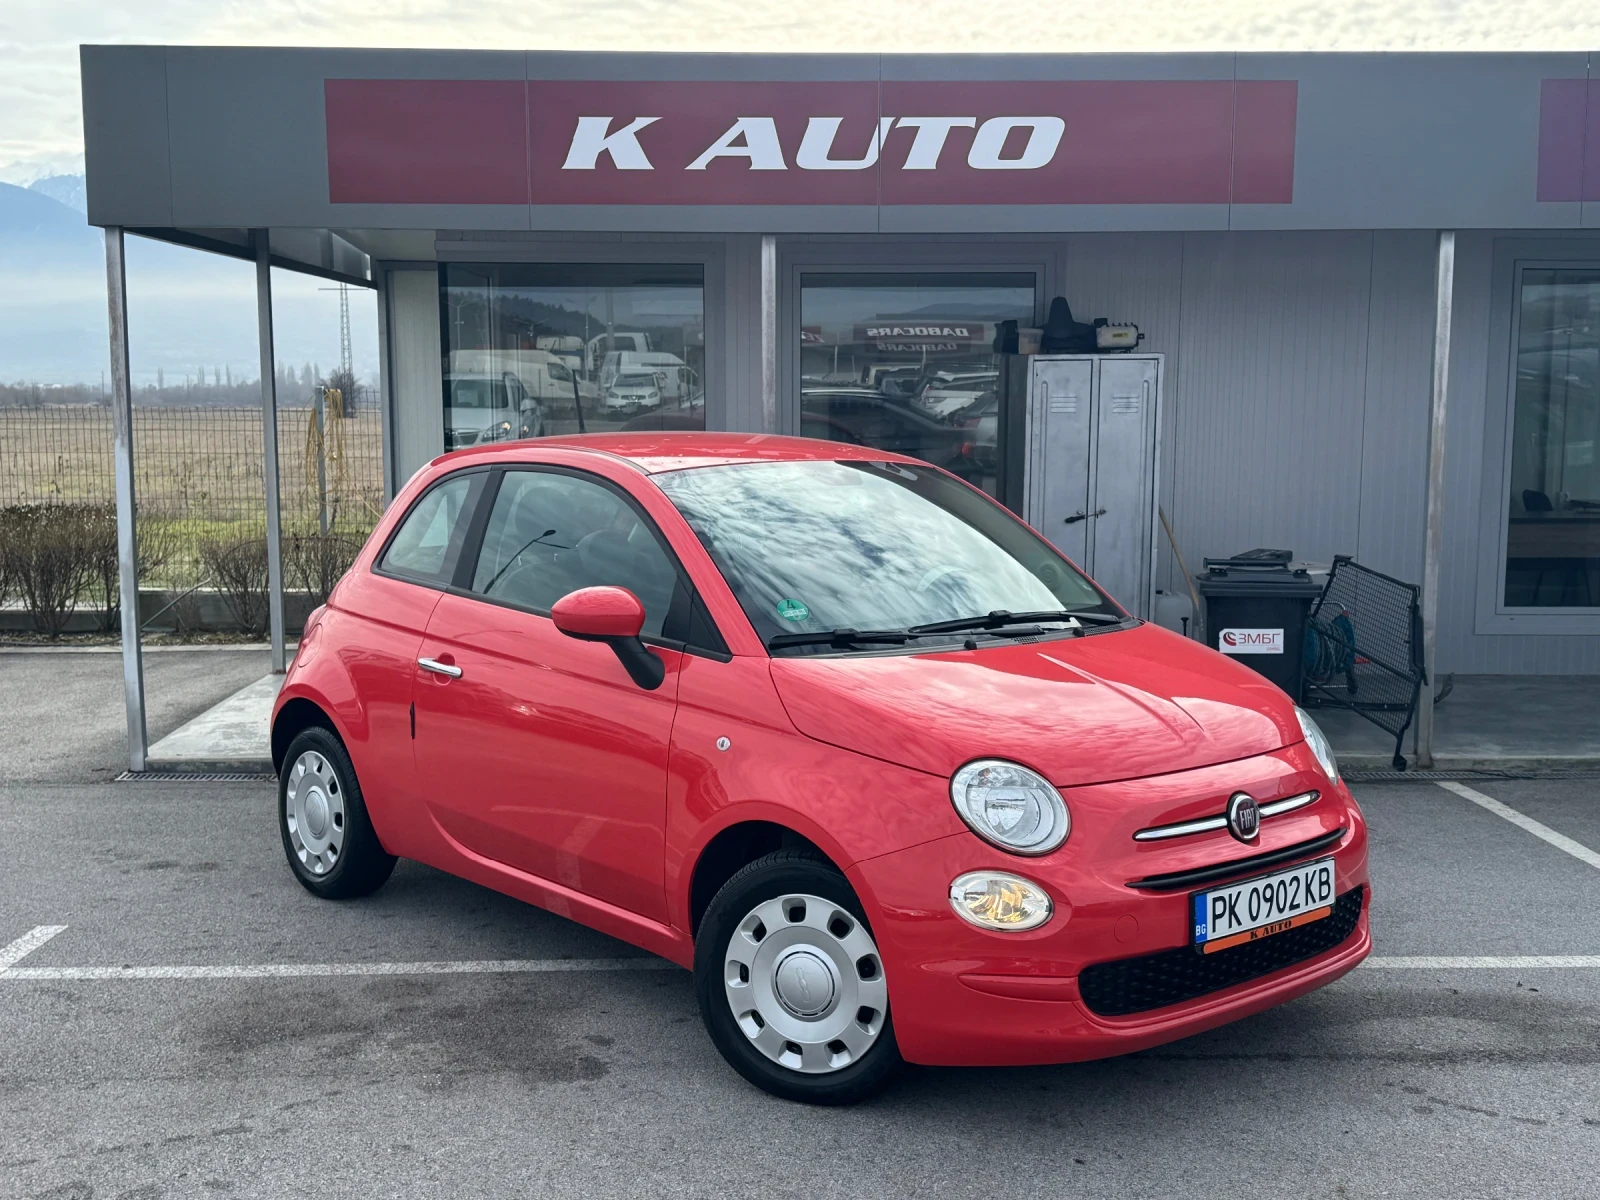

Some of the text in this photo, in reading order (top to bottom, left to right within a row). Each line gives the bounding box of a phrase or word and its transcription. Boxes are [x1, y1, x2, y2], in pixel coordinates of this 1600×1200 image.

[561, 116, 1066, 170] K AUTO
[1239, 633, 1280, 644] ЗМБГ
[1239, 808, 1255, 829] FIAT
[1212, 867, 1331, 933] PK 0902 KB
[1195, 924, 1207, 936] BG
[1249, 920, 1292, 940] K AUTO
